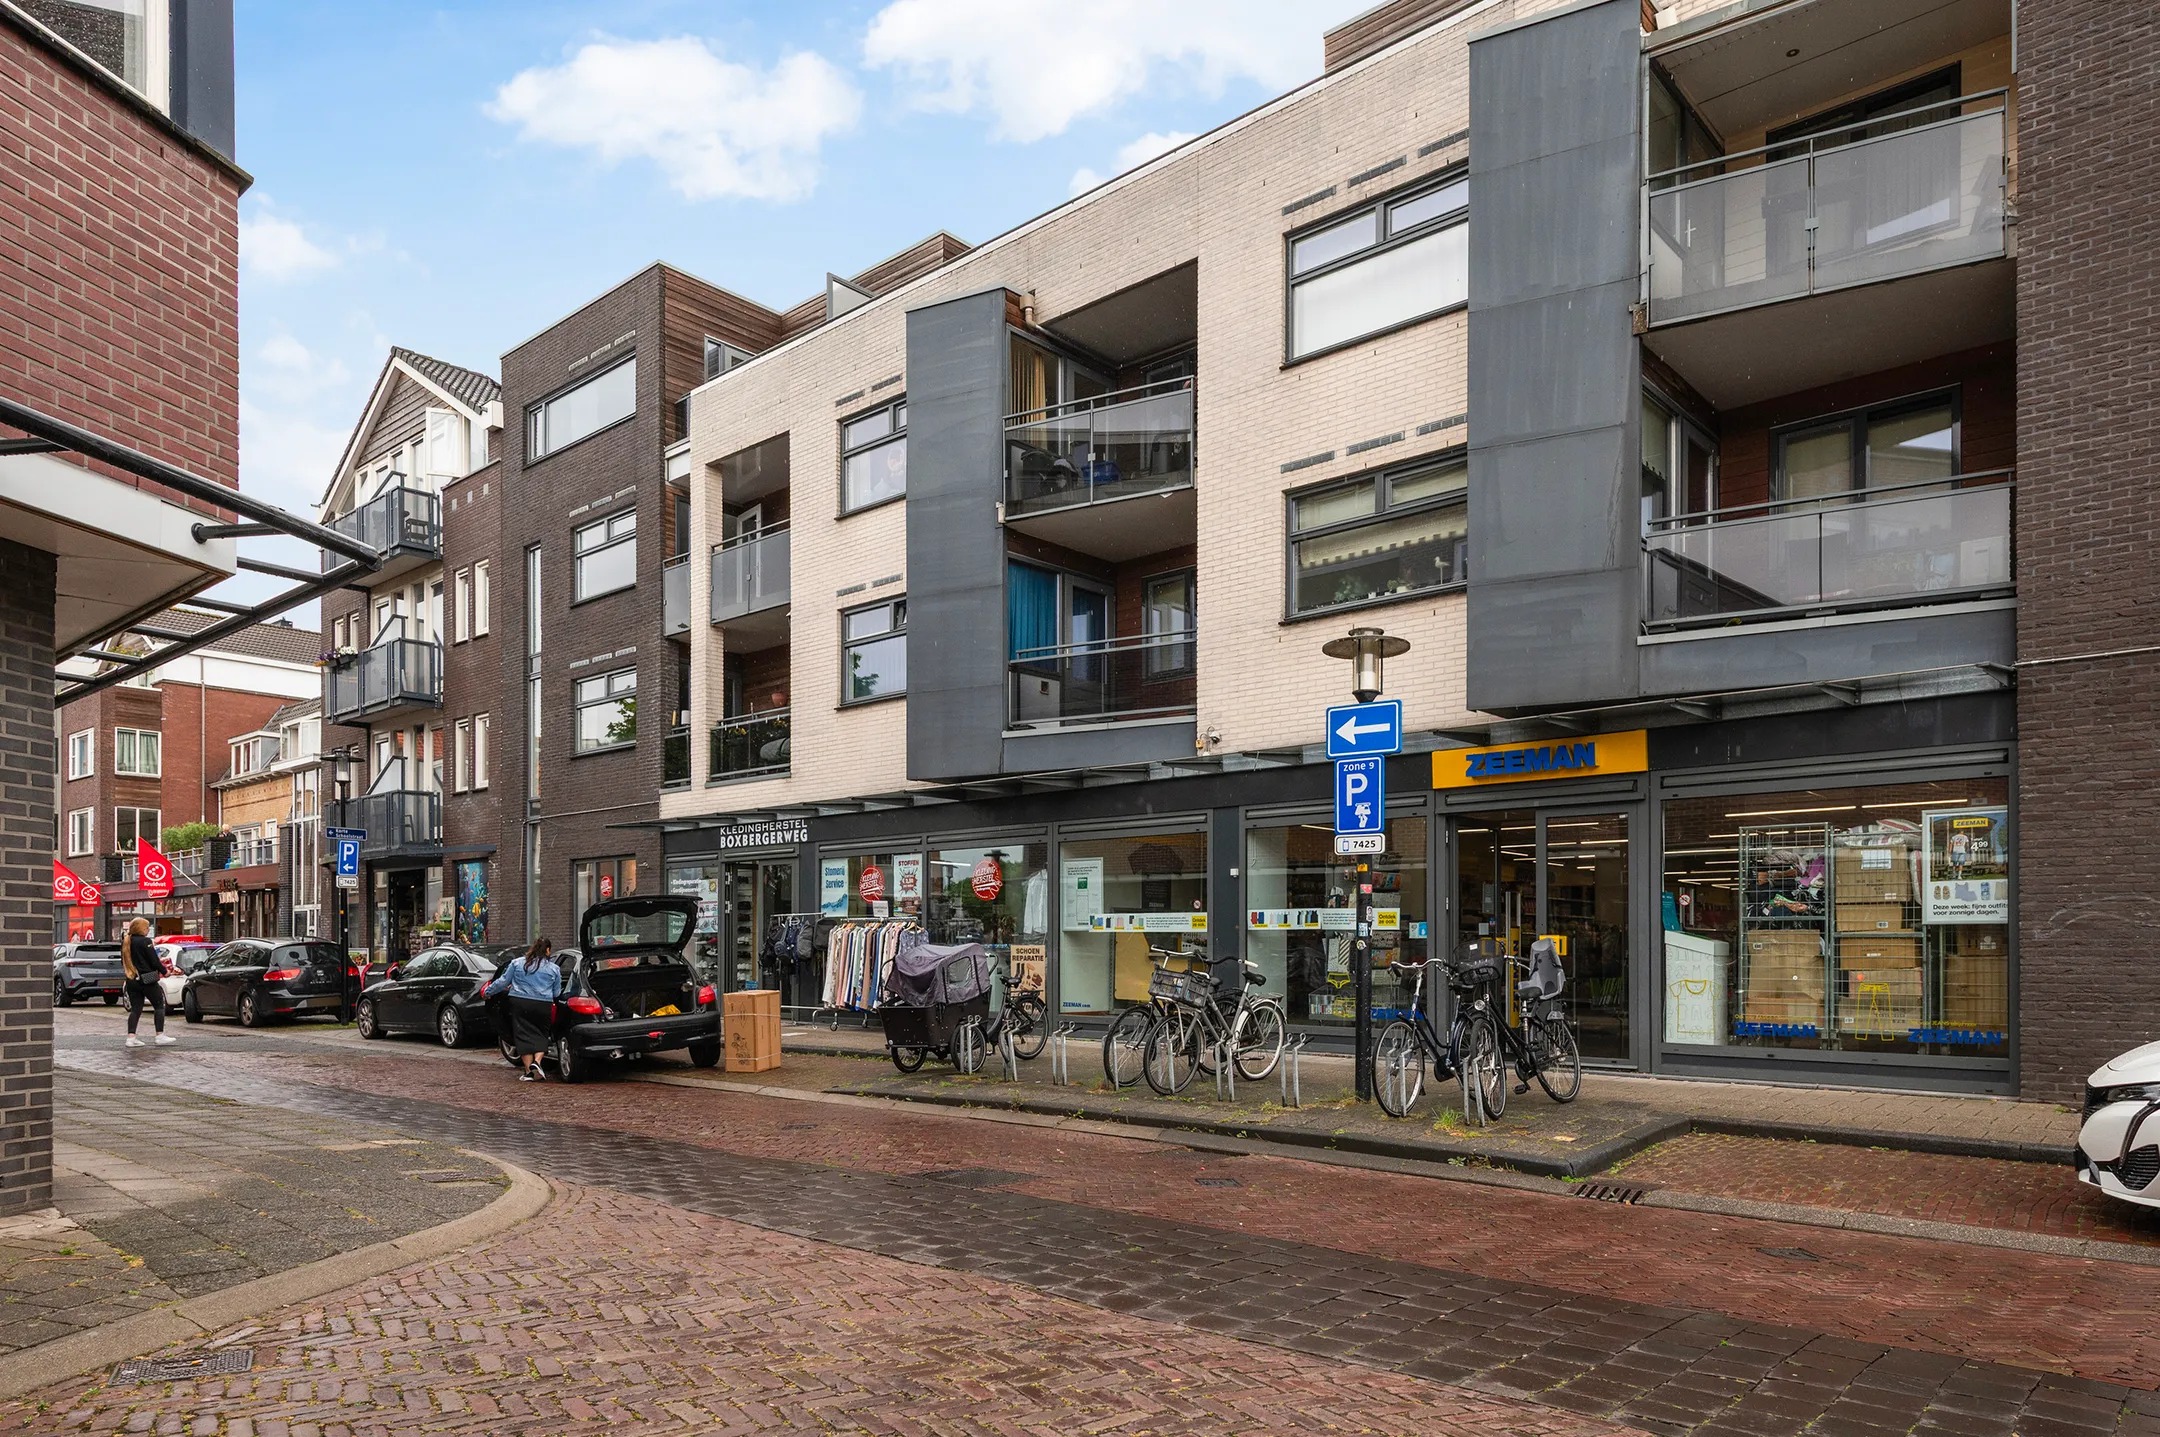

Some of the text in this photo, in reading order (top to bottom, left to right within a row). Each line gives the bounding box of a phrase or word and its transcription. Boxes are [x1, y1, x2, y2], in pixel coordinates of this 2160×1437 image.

[1343, 762, 1375, 771] zone 9
[1465, 742, 1596, 777] ZEEMAN
[1346, 773, 1368, 806] P
[720, 819, 807, 836] KLEDINGHERSTEL
[720, 829, 808, 849] BOXBERGERWEG
[1353, 840, 1376, 848] 7425
[344, 843, 355, 861] P
[825, 879, 844, 889] Service
[1734, 1021, 1816, 1039] ZEEMAN
[1907, 1028, 2002, 1045] ZEEMAN
